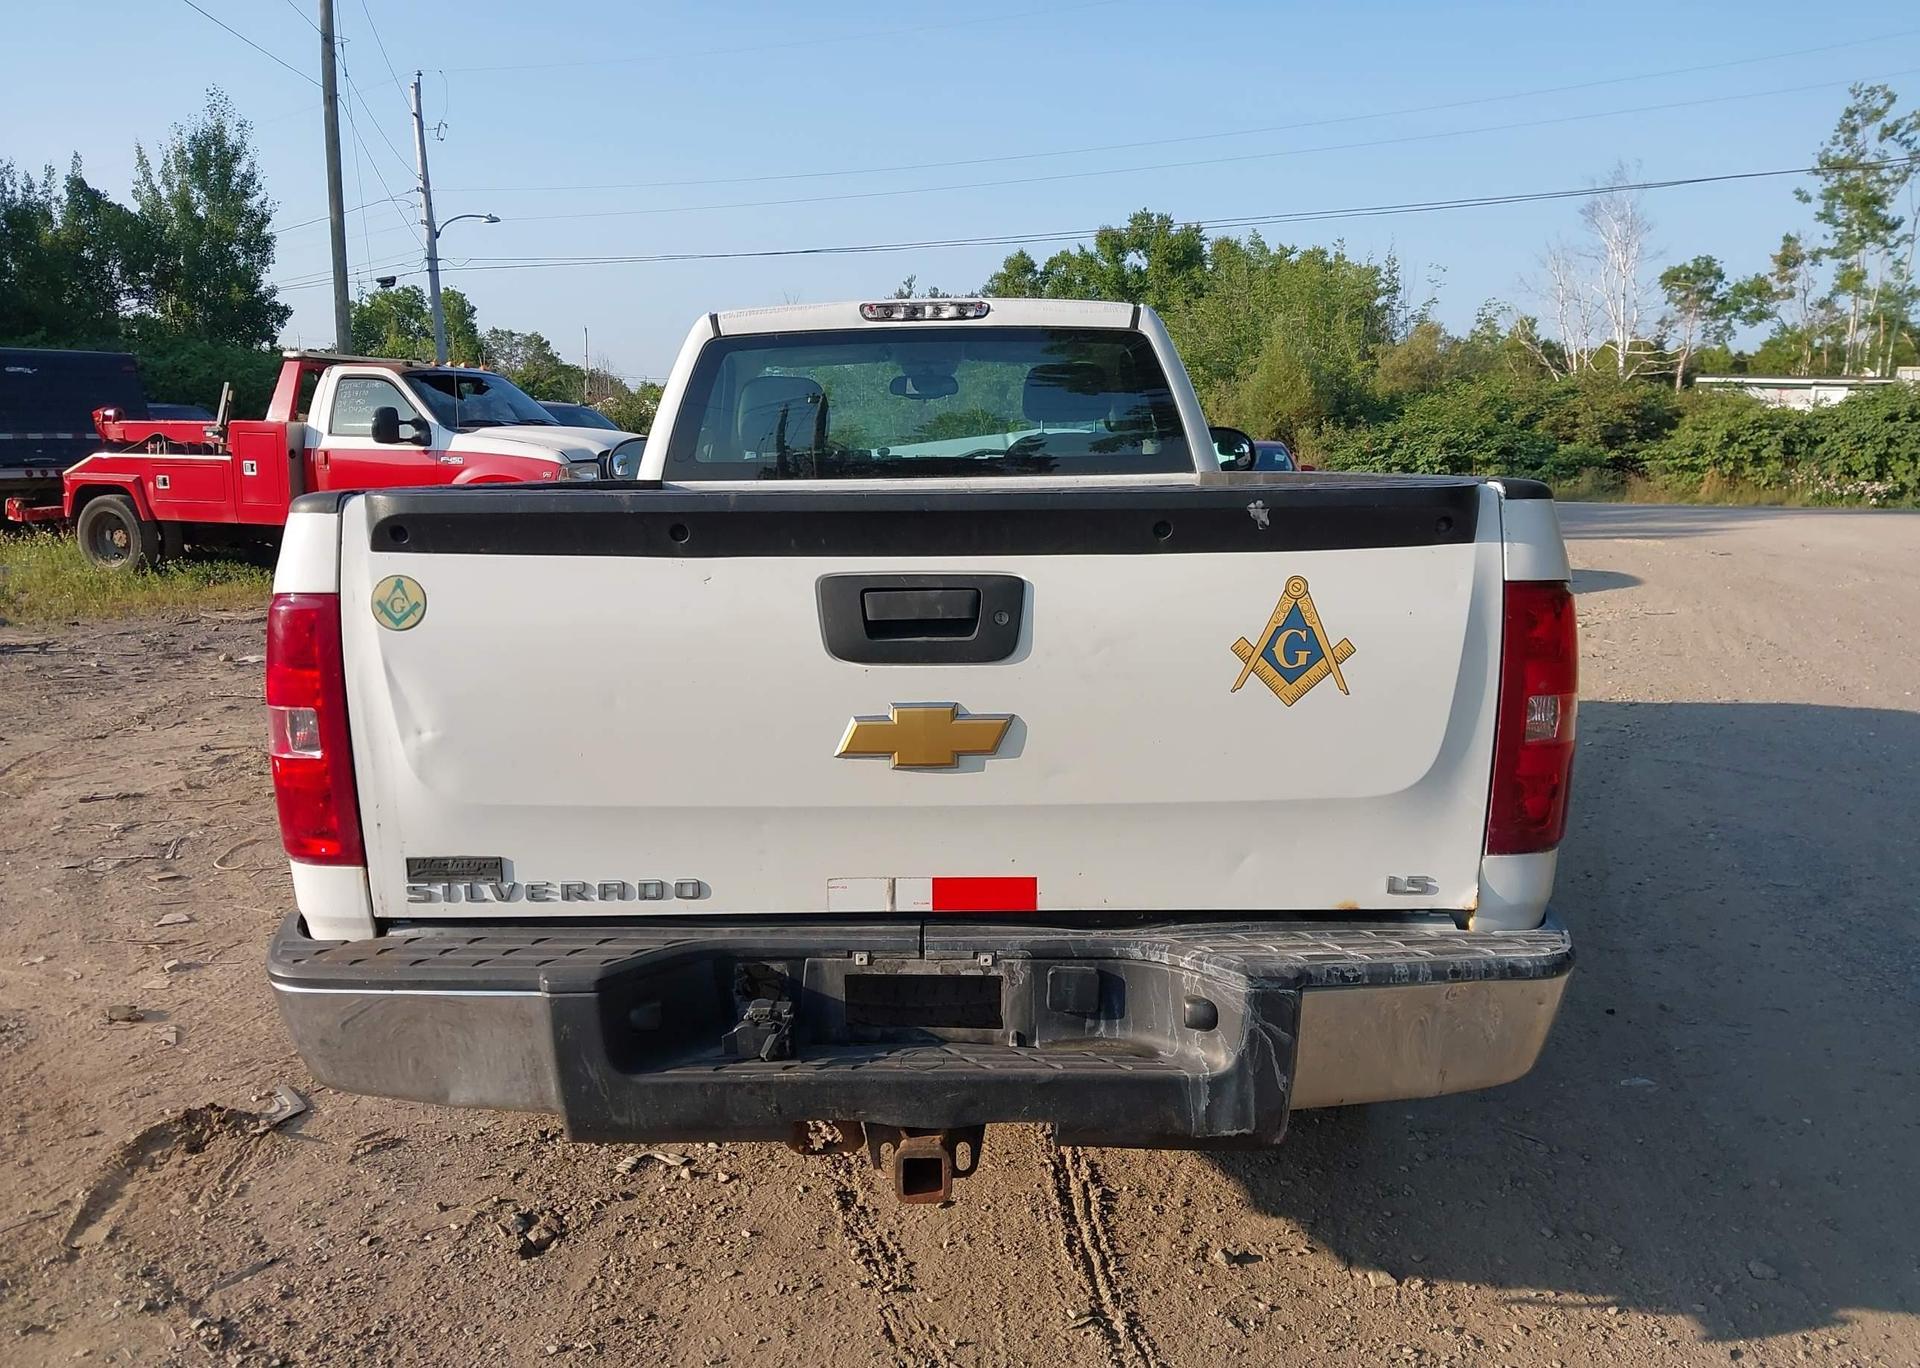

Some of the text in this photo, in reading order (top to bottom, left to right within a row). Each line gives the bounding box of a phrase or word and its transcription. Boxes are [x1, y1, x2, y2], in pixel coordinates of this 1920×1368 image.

[390, 597, 406, 614] G
[1272, 627, 1312, 669] G
[406, 878, 701, 903] SILVERADO
[1386, 876, 1431, 895] LS
